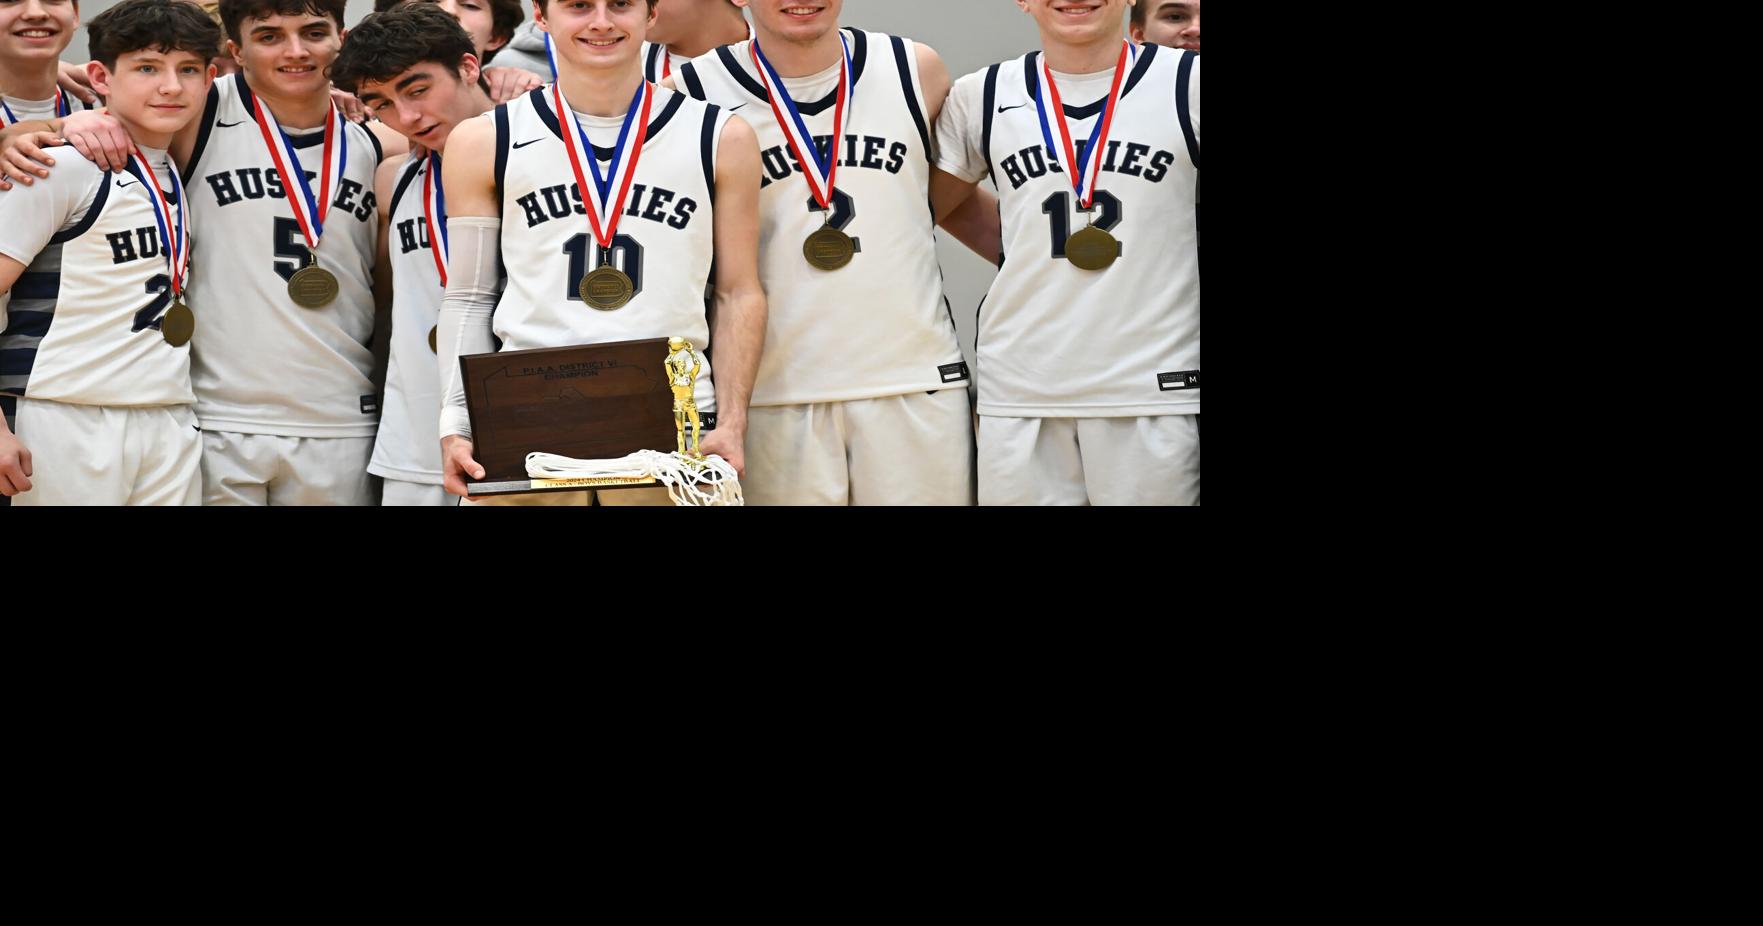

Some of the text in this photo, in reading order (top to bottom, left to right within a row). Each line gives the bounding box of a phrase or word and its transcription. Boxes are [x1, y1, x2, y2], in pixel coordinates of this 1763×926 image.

[760, 134, 907, 189] USKIES
[205, 168, 376, 222] HUSES
[515, 182, 697, 230] HUSIES
[807, 186, 861, 253] 2
[1042, 190, 1122, 258] 12
[274, 216, 317, 283] 5
[562, 232, 644, 301] 10
[559, 361, 603, 371] DISTRICT
